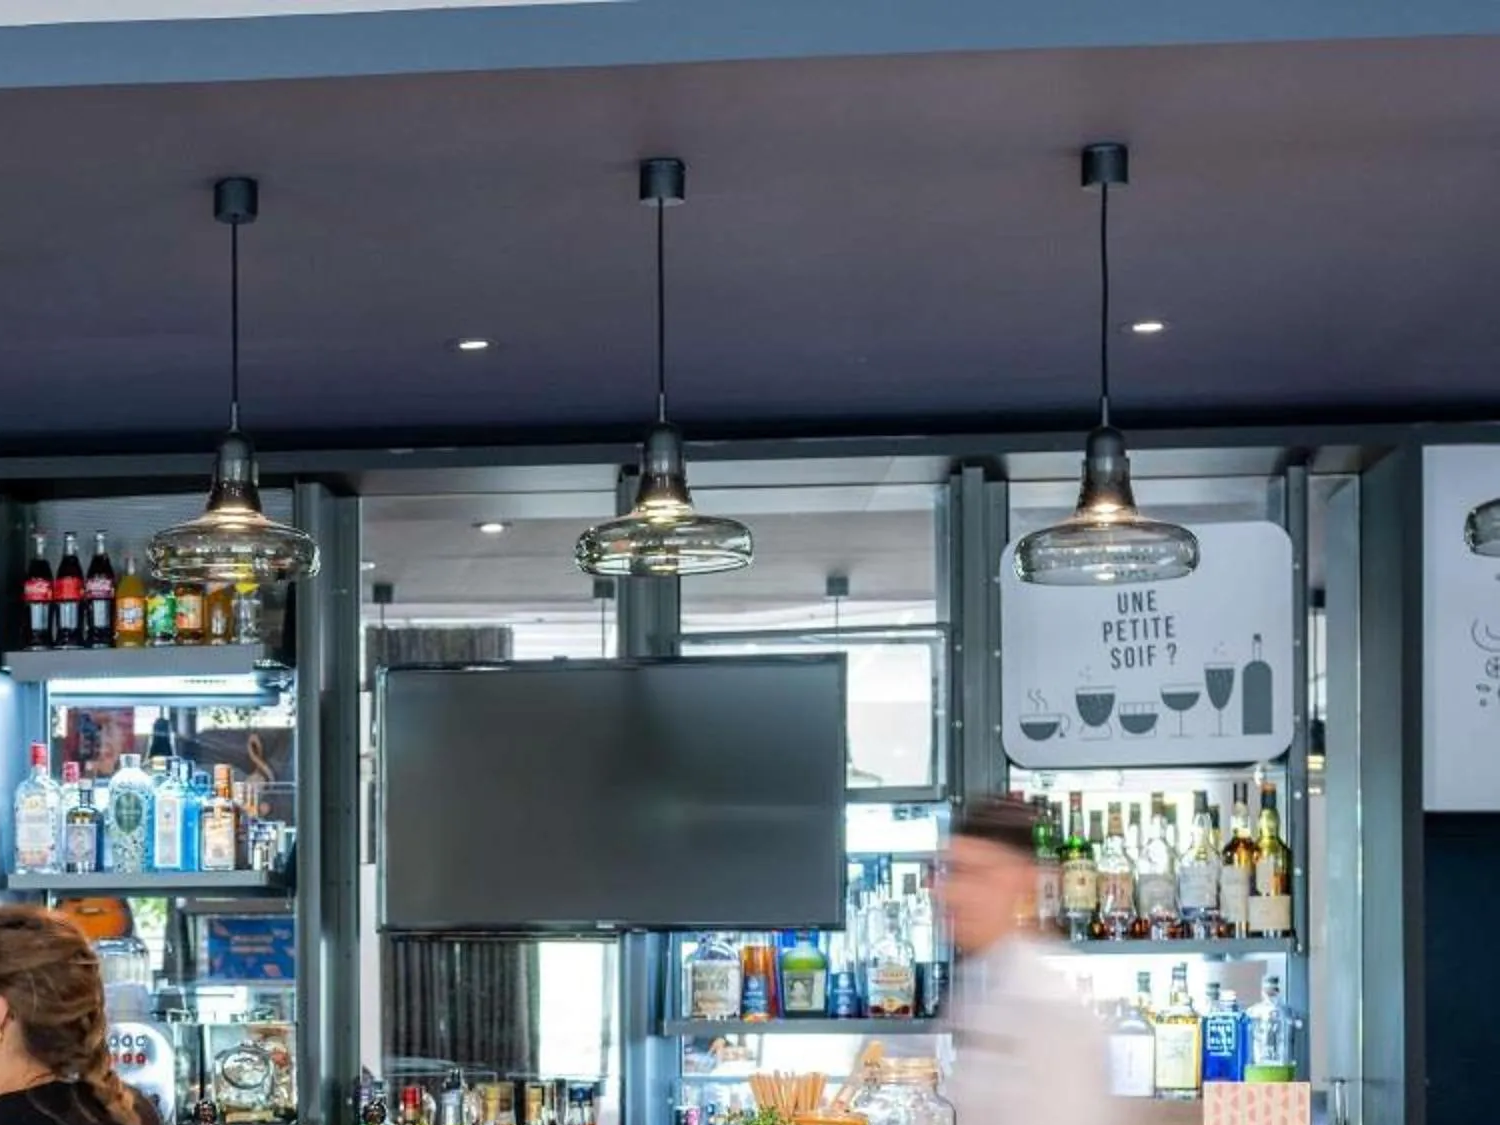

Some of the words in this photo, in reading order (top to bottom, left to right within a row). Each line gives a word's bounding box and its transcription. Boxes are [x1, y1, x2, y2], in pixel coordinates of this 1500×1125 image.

[1116, 589, 1158, 614] UNE
[1102, 615, 1176, 643] PETITE
[1110, 643, 1157, 670] SOIF
